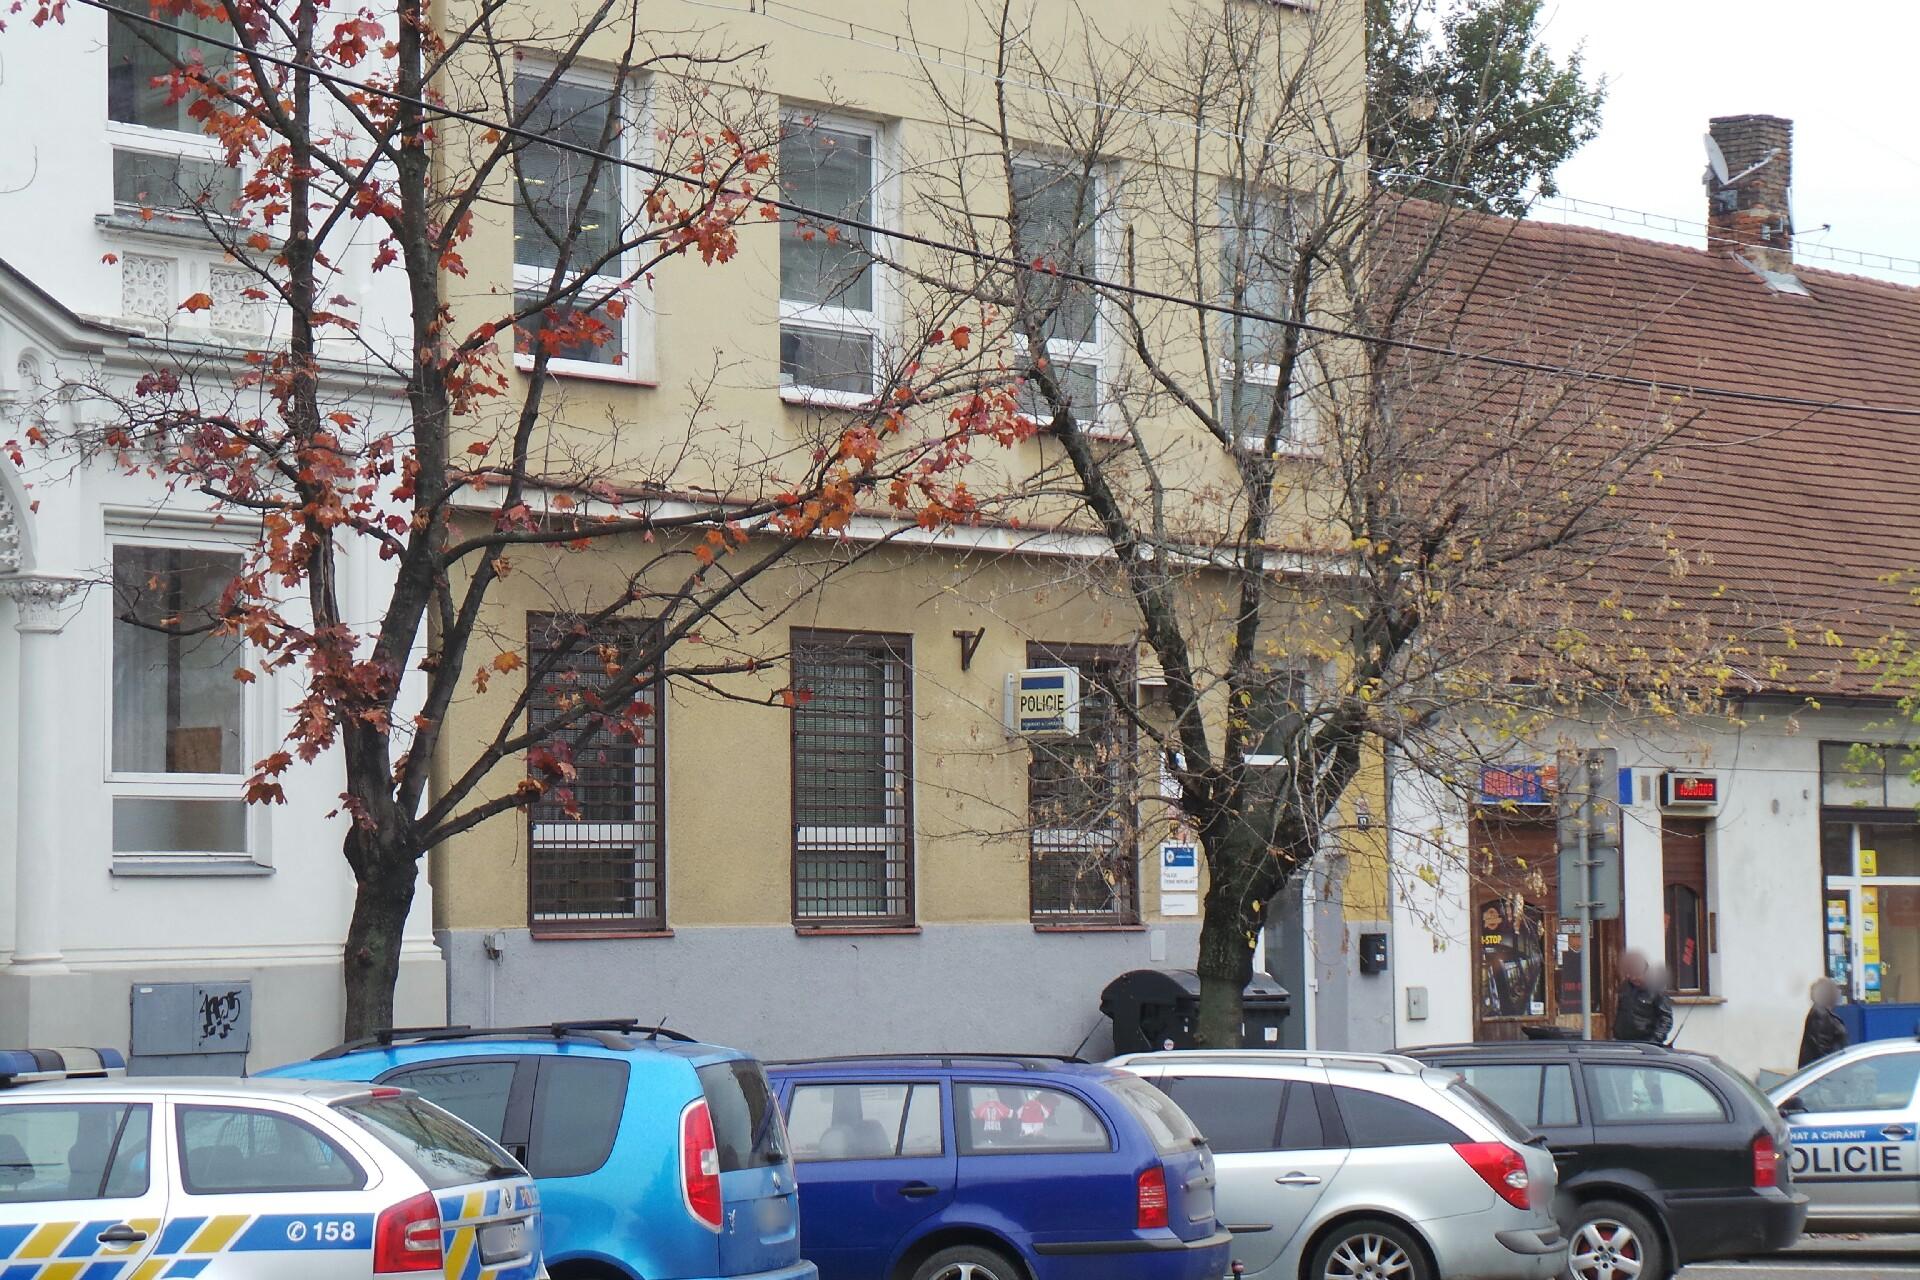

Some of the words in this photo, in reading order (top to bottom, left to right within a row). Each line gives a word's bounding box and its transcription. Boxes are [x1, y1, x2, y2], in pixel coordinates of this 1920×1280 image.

[1020, 694, 1064, 712] POLICIE
[1812, 1132, 1819, 1140] A
[313, 1221, 356, 1241] 158
